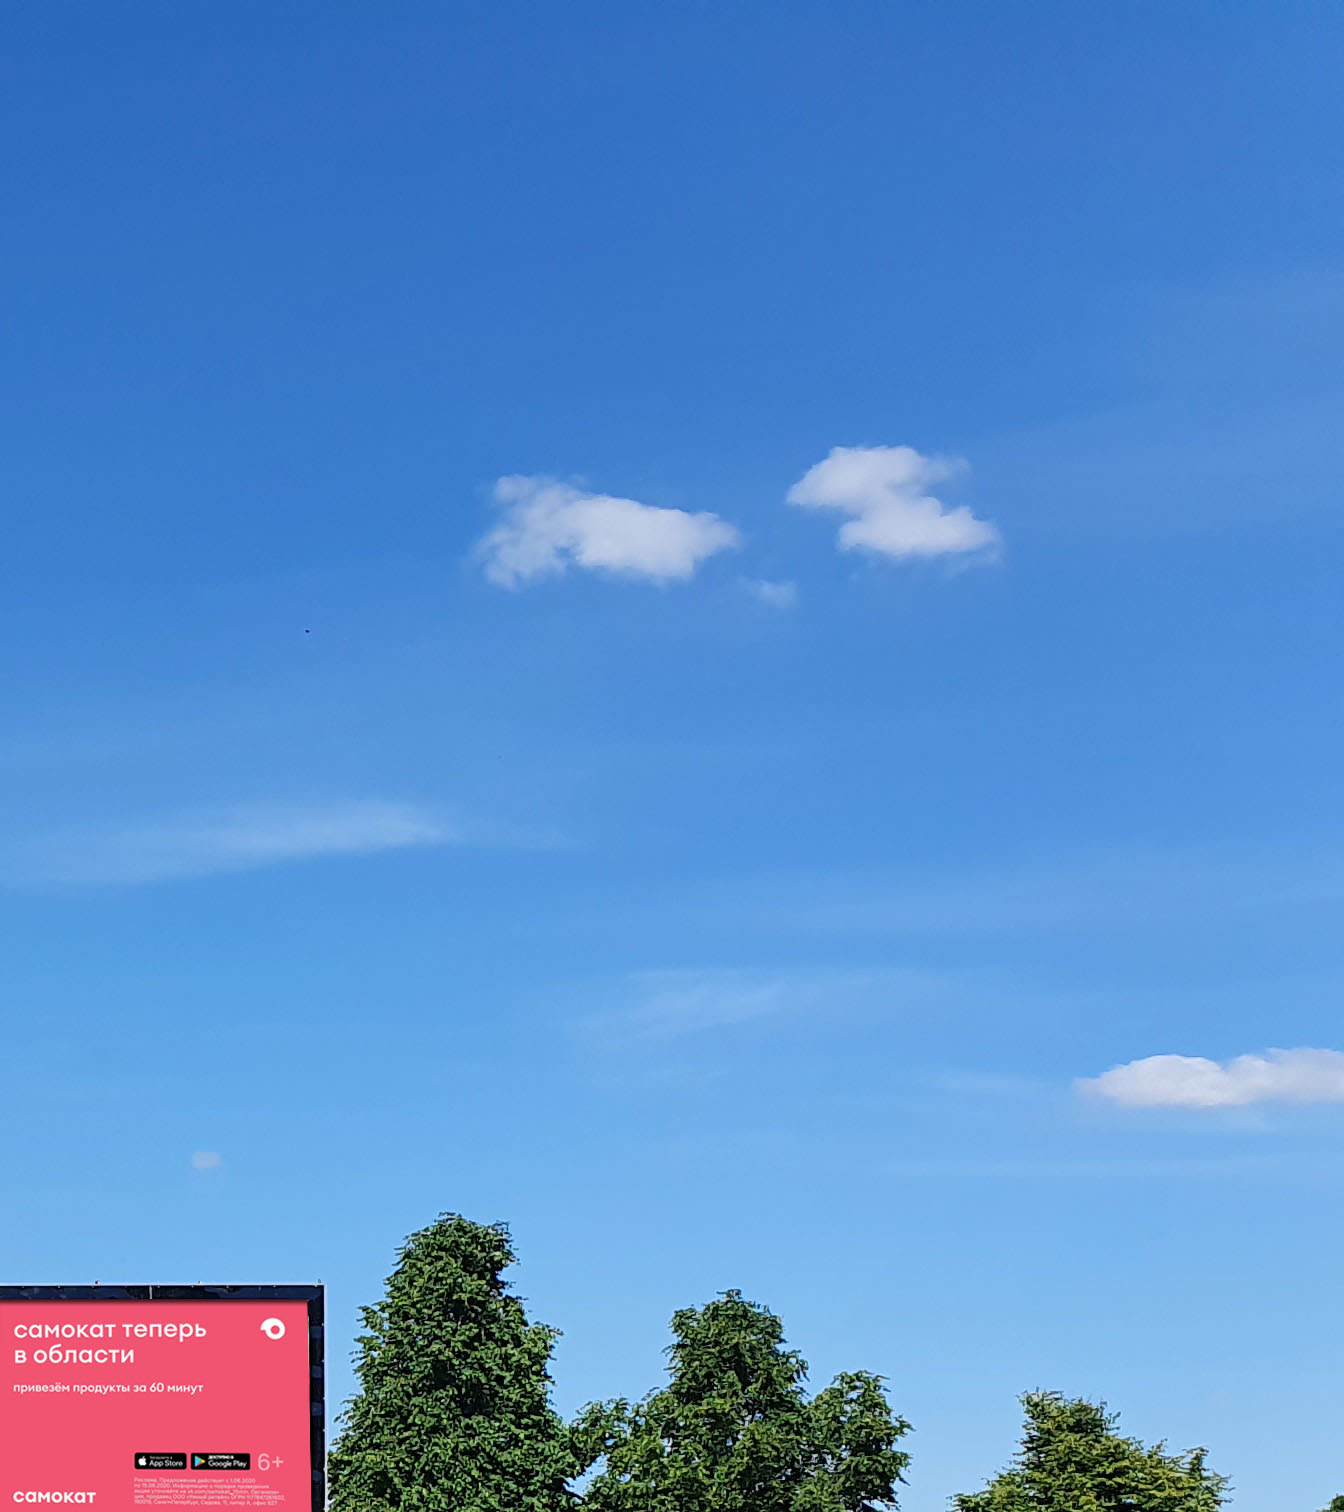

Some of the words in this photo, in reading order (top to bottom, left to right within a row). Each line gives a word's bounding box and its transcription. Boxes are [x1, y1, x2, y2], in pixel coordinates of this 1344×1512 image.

[14, 1323, 116, 1338] самокат
[121, 1322, 207, 1342] теперь
[14, 1349, 27, 1364] в
[33, 1343, 135, 1364] области
[13, 1382, 70, 1394] привезём
[72, 1384, 130, 1395] продукты
[133, 1384, 147, 1393] за
[149, 1382, 164, 1393] 60
[167, 1384, 204, 1395] минут
[208, 1460, 232, 1468] Google
[233, 1460, 248, 1468] Play
[257, 1453, 284, 1471] 6+
[13, 1490, 96, 1504] самокат
